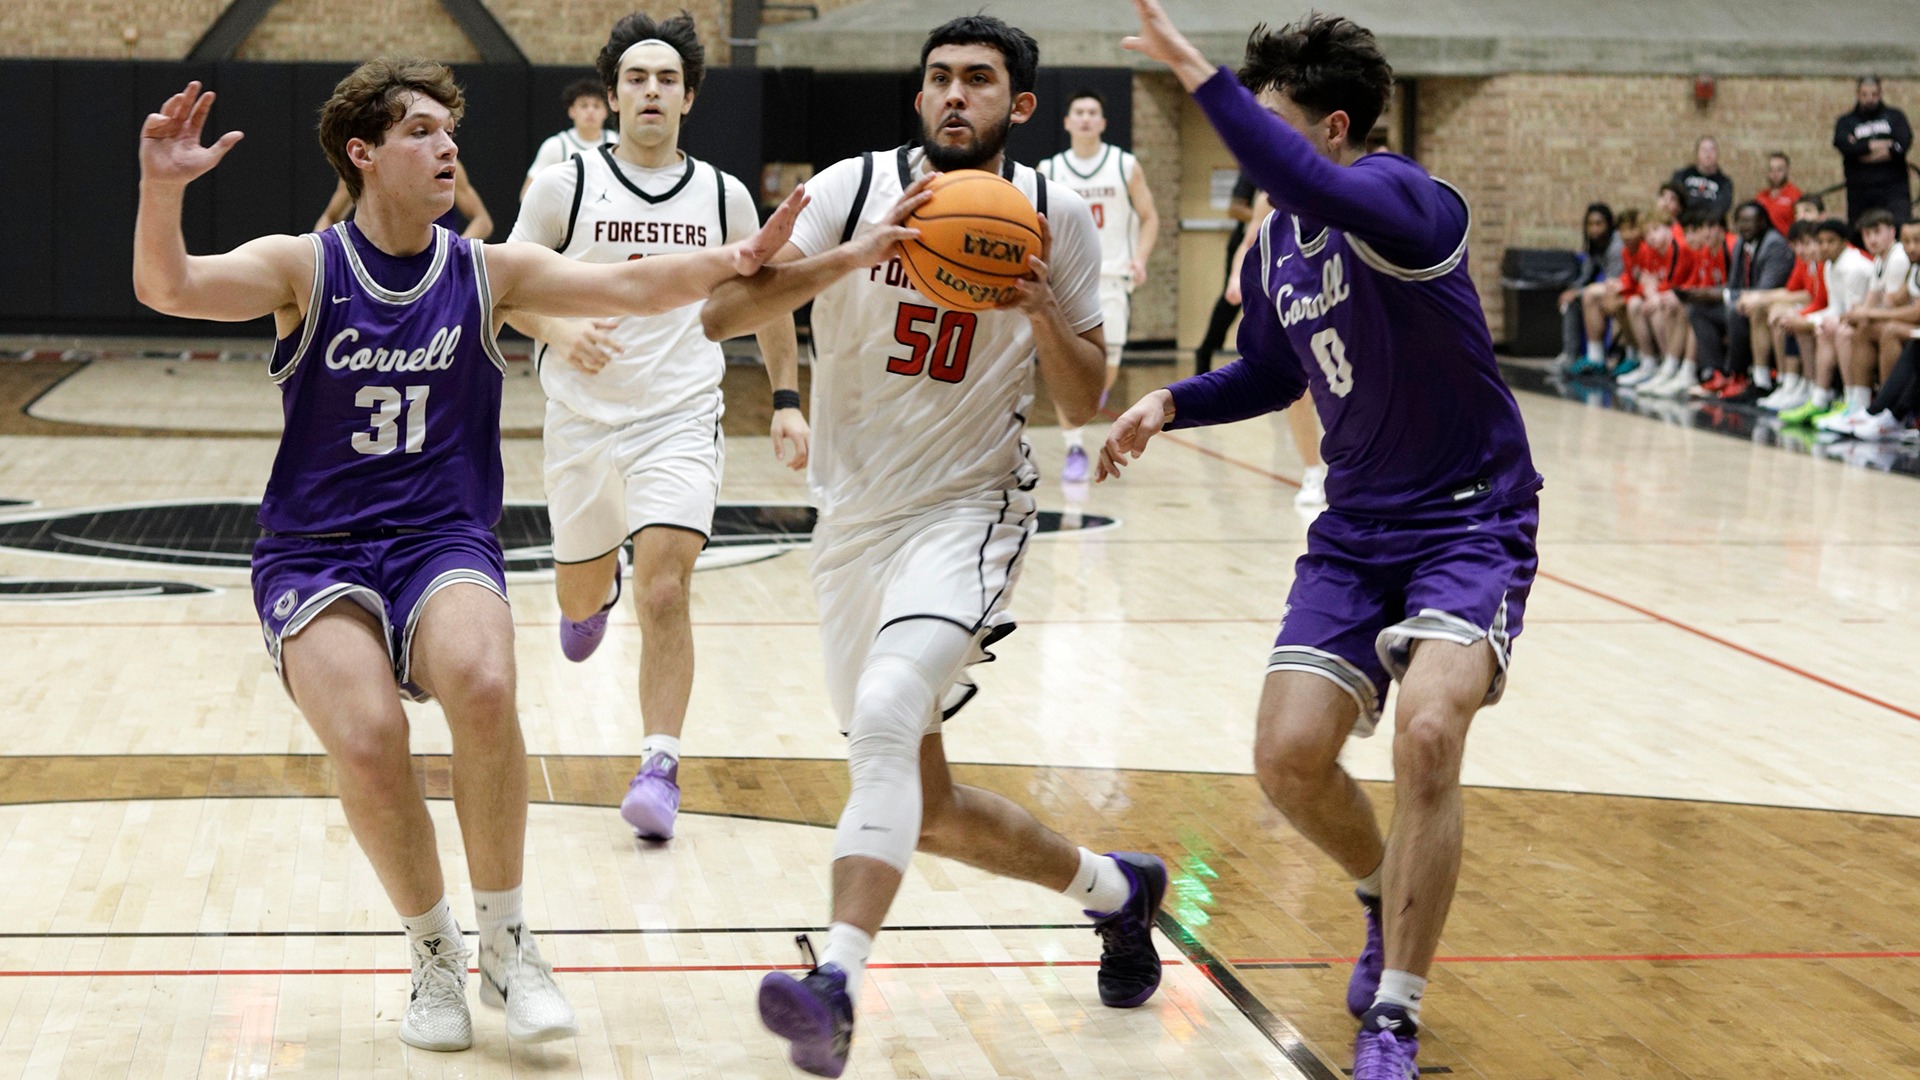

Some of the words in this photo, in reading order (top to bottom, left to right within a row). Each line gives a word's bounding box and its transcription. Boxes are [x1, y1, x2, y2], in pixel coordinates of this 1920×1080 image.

[594, 220, 707, 247] FORESTERS
[963, 233, 1026, 264] NCAA
[325, 324, 462, 372] Cornell
[886, 301, 978, 384] 50
[1310, 327, 1354, 398] 0
[351, 385, 430, 455] 31
